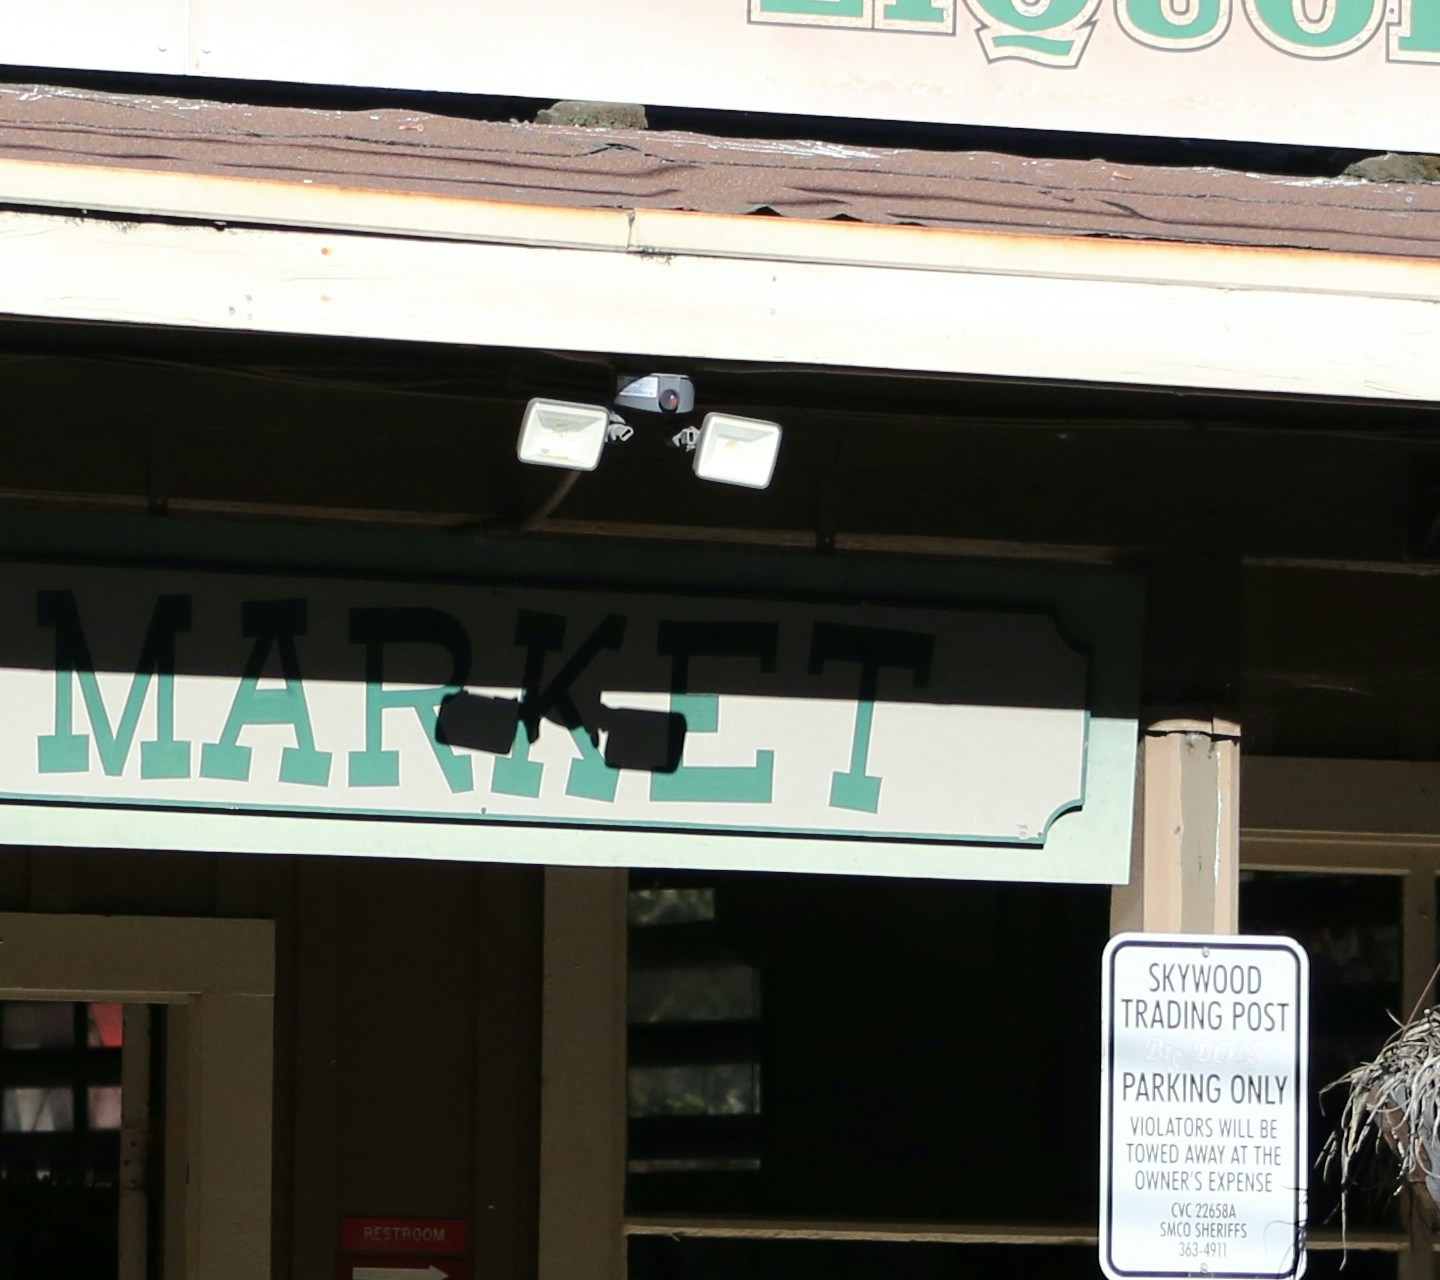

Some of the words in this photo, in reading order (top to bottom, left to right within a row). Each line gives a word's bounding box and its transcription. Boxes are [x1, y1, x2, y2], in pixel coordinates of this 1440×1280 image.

[36, 588, 936, 816] MARKET
[1148, 962, 1262, 994] SKYWOOD
[1121, 999, 1223, 1030] TRADING
[1232, 1002, 1290, 1032] POST
[1122, 1072, 1222, 1103] PARKING
[1230, 1074, 1288, 1105] ONLY
[1130, 1116, 1213, 1138] VIOLATORS
[1218, 1119, 1254, 1139] WILL
[1260, 1119, 1278, 1139] BE
[1126, 1143, 1179, 1163] TOWED
[1185, 1144, 1226, 1164] AWAY
[1230, 1145, 1248, 1165] AT
[1253, 1146, 1281, 1166] THE
[1135, 1170, 1202, 1191] OWNER'S
[1209, 1172, 1272, 1192] EXPENSE
[1171, 1202, 1192, 1218] CVC
[1195, 1203, 1237, 1219] 22658A
[363, 1225, 446, 1242] RESTROOM
[1160, 1222, 1191, 1237] SMCO
[1195, 1223, 1247, 1238] SHERIFFS
[1178, 1242, 1227, 1257] 363-4911
